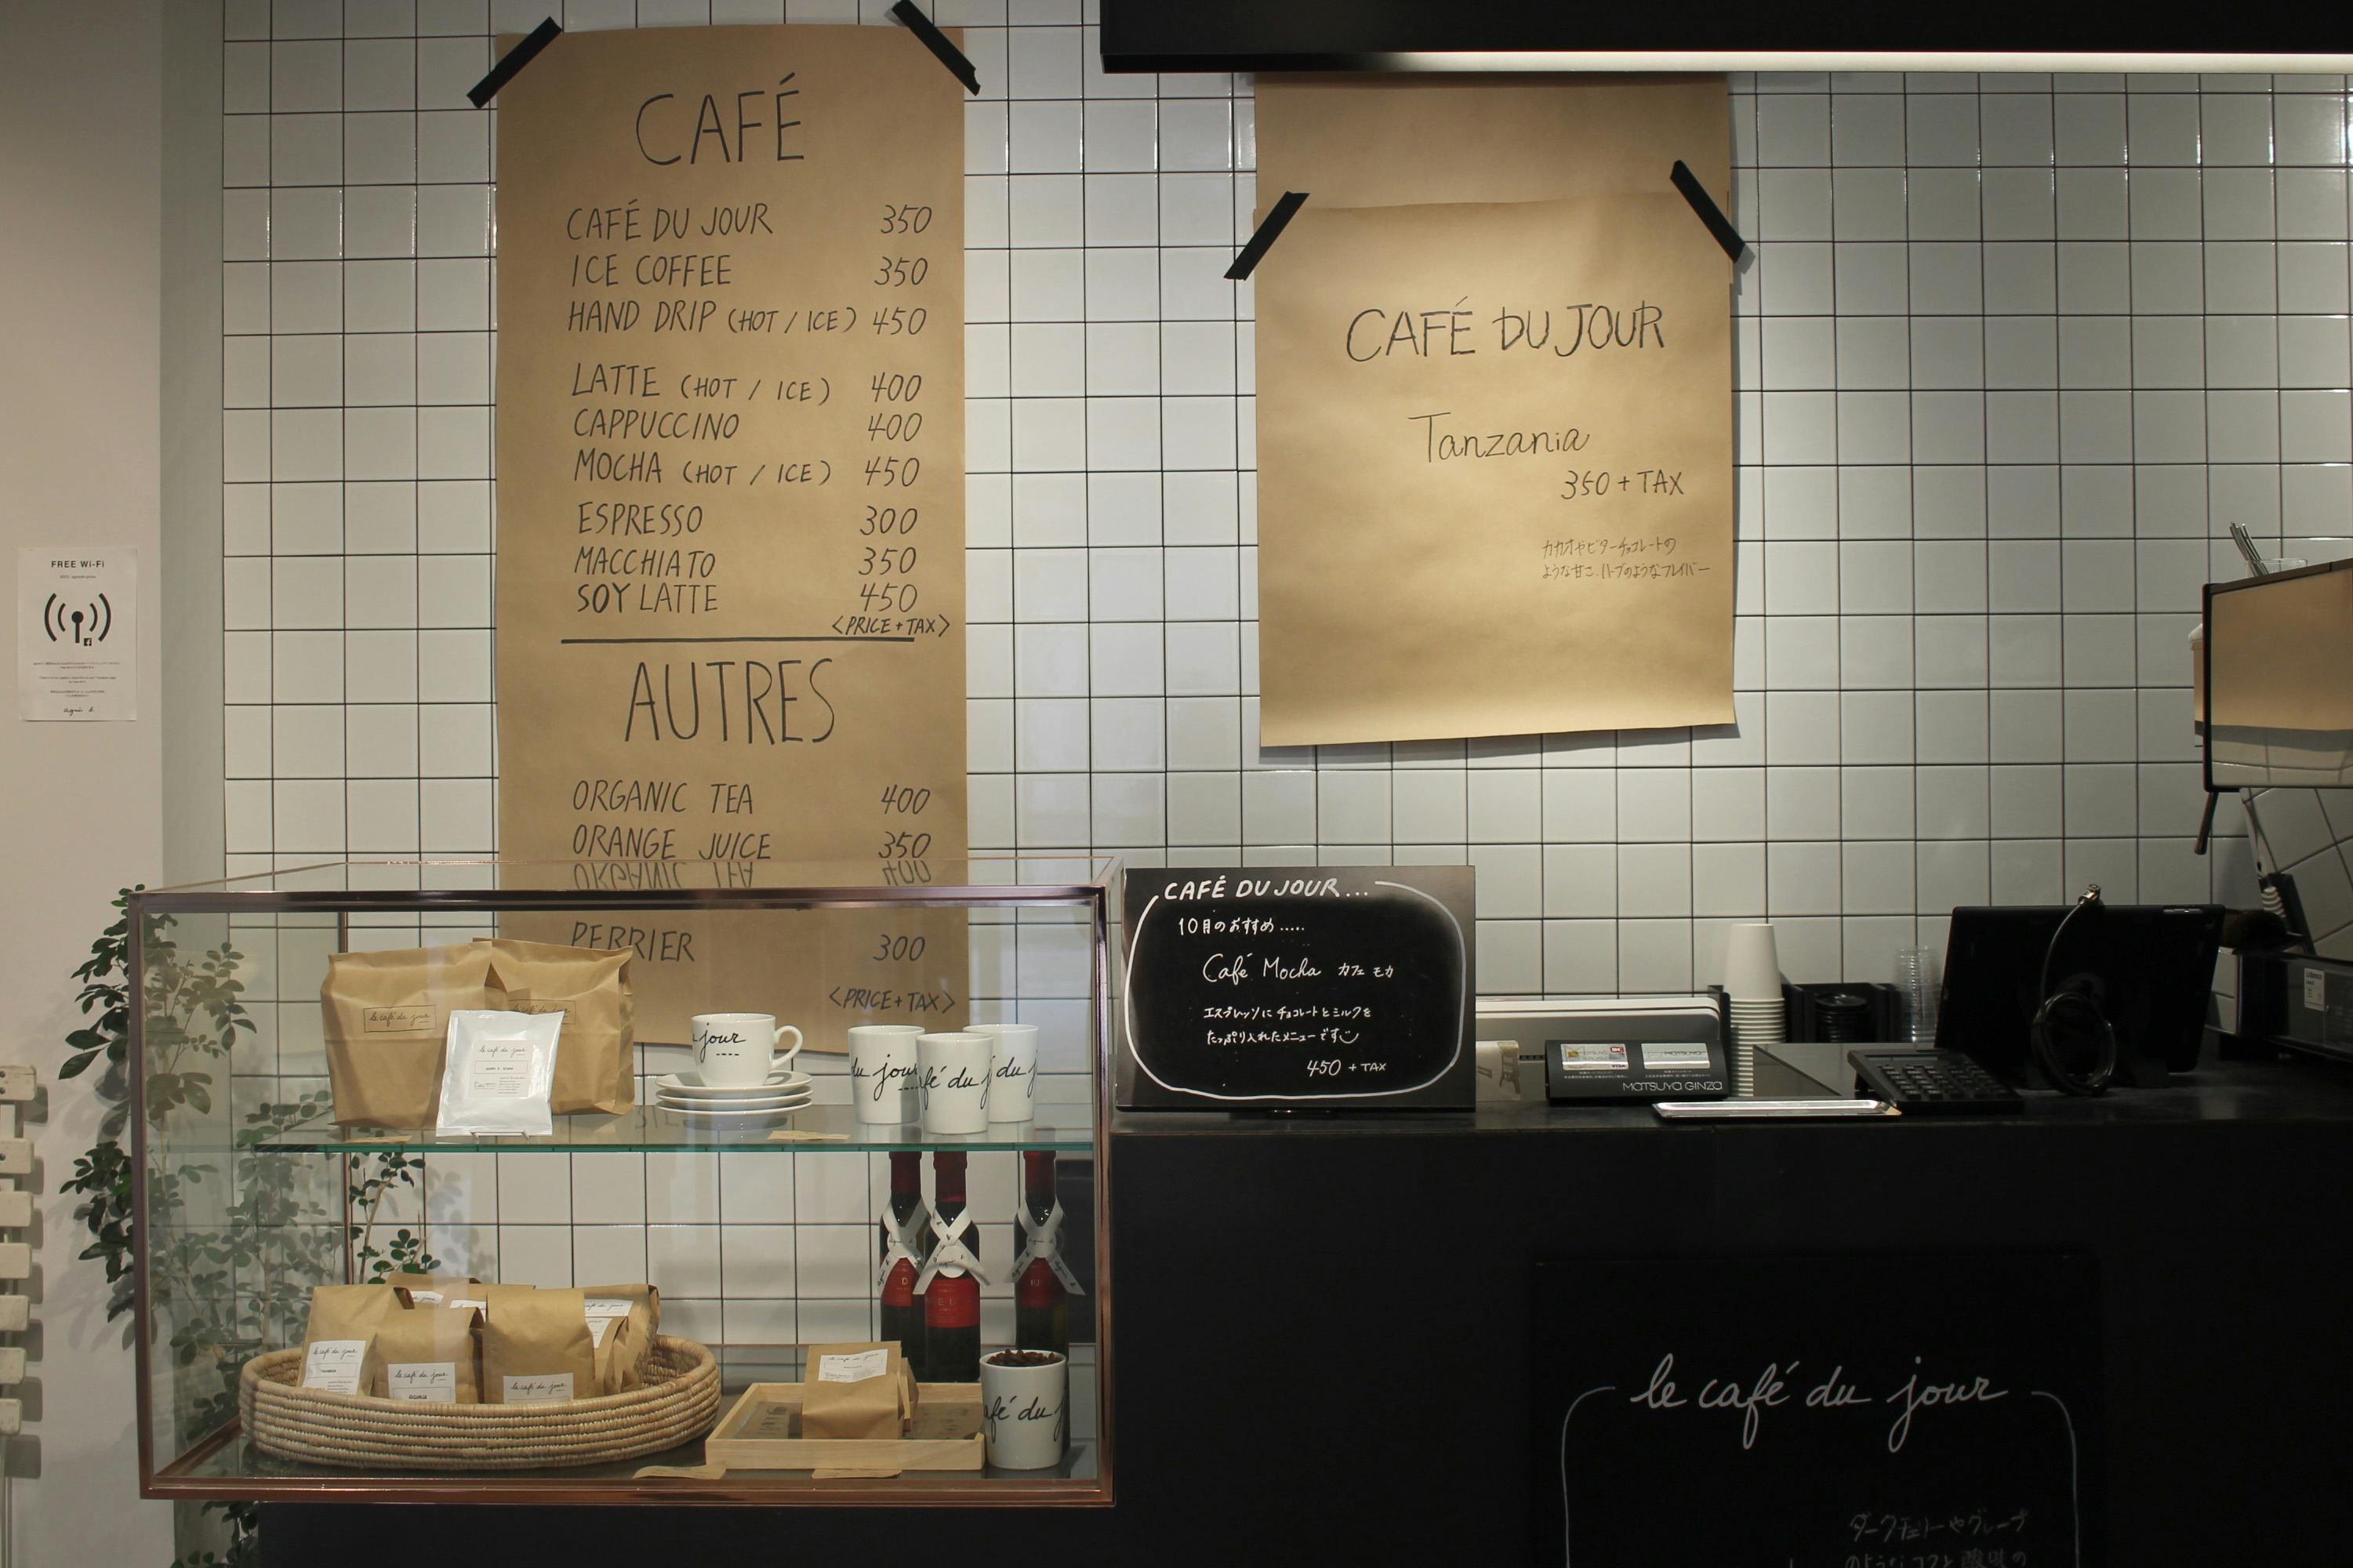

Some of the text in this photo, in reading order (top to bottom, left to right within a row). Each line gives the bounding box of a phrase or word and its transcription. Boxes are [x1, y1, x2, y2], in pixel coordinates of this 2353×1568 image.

[636, 72, 804, 165] CAFÉ
[567, 199, 932, 241] CAFÉ DU JOUR 350
[572, 254, 928, 287] ICE COFFEE 350
[568, 300, 639, 333] HAND
[654, 300, 716, 332] DRIP
[873, 307, 926, 335] 450
[1346, 296, 1665, 361] CAFÉ DU JOUR
[572, 363, 659, 397] LATTE
[872, 372, 921, 402] 400
[574, 408, 922, 441] CAPPUCCINO 400
[1408, 412, 1589, 463] Tanzania
[575, 448, 662, 483] MOCHA
[866, 456, 919, 487] 450
[1562, 470, 1609, 499] 350
[1637, 470, 1683, 495] TAX
[579, 502, 917, 536] ESPRESSO 300
[574, 546, 916, 579] MACCHIATO 350
[578, 583, 917, 614] SOY LATTE 450
[625, 659, 834, 745] AUTRES
[573, 779, 930, 815] ORGANIC TEA 400
[573, 824, 931, 861] ORANGE JUICE 350
[1164, 875, 1227, 901] CAFÉ
[1236, 880, 1271, 897] DU
[873, 934, 925, 960] 300
[1203, 953, 1394, 985] Café Mocha カフェ モカ
[699, 1022, 746, 1062] jour
[948, 1067, 979, 1088] du
[997, 1057, 1026, 1077] du
[1307, 1060, 1341, 1076] 450
[1018, 1396, 1052, 1421] du
[1631, 1353, 2008, 1452] le café du jour
